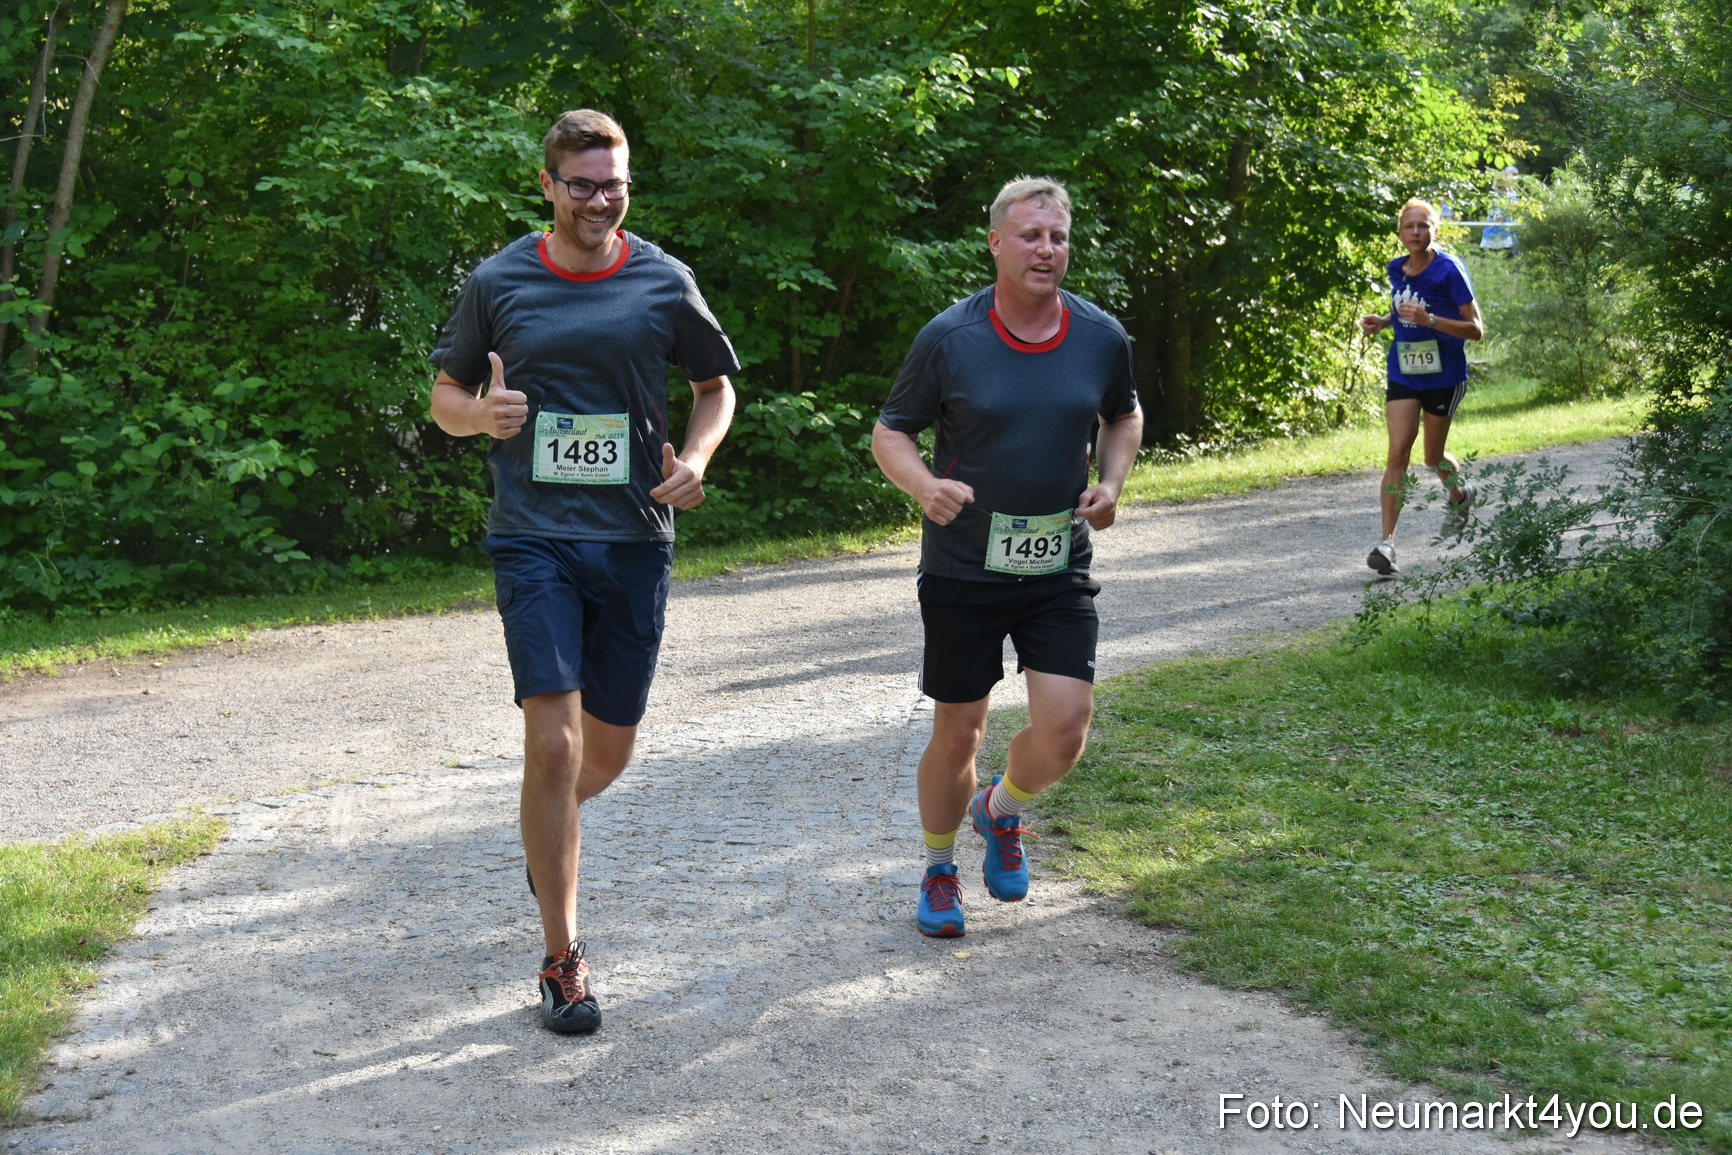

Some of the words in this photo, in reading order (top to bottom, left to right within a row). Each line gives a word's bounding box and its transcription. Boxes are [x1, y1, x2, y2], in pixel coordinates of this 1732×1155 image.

[1403, 352, 1434, 365] 1719
[547, 439, 618, 465] 1483
[1001, 534, 1062, 558] 1493
